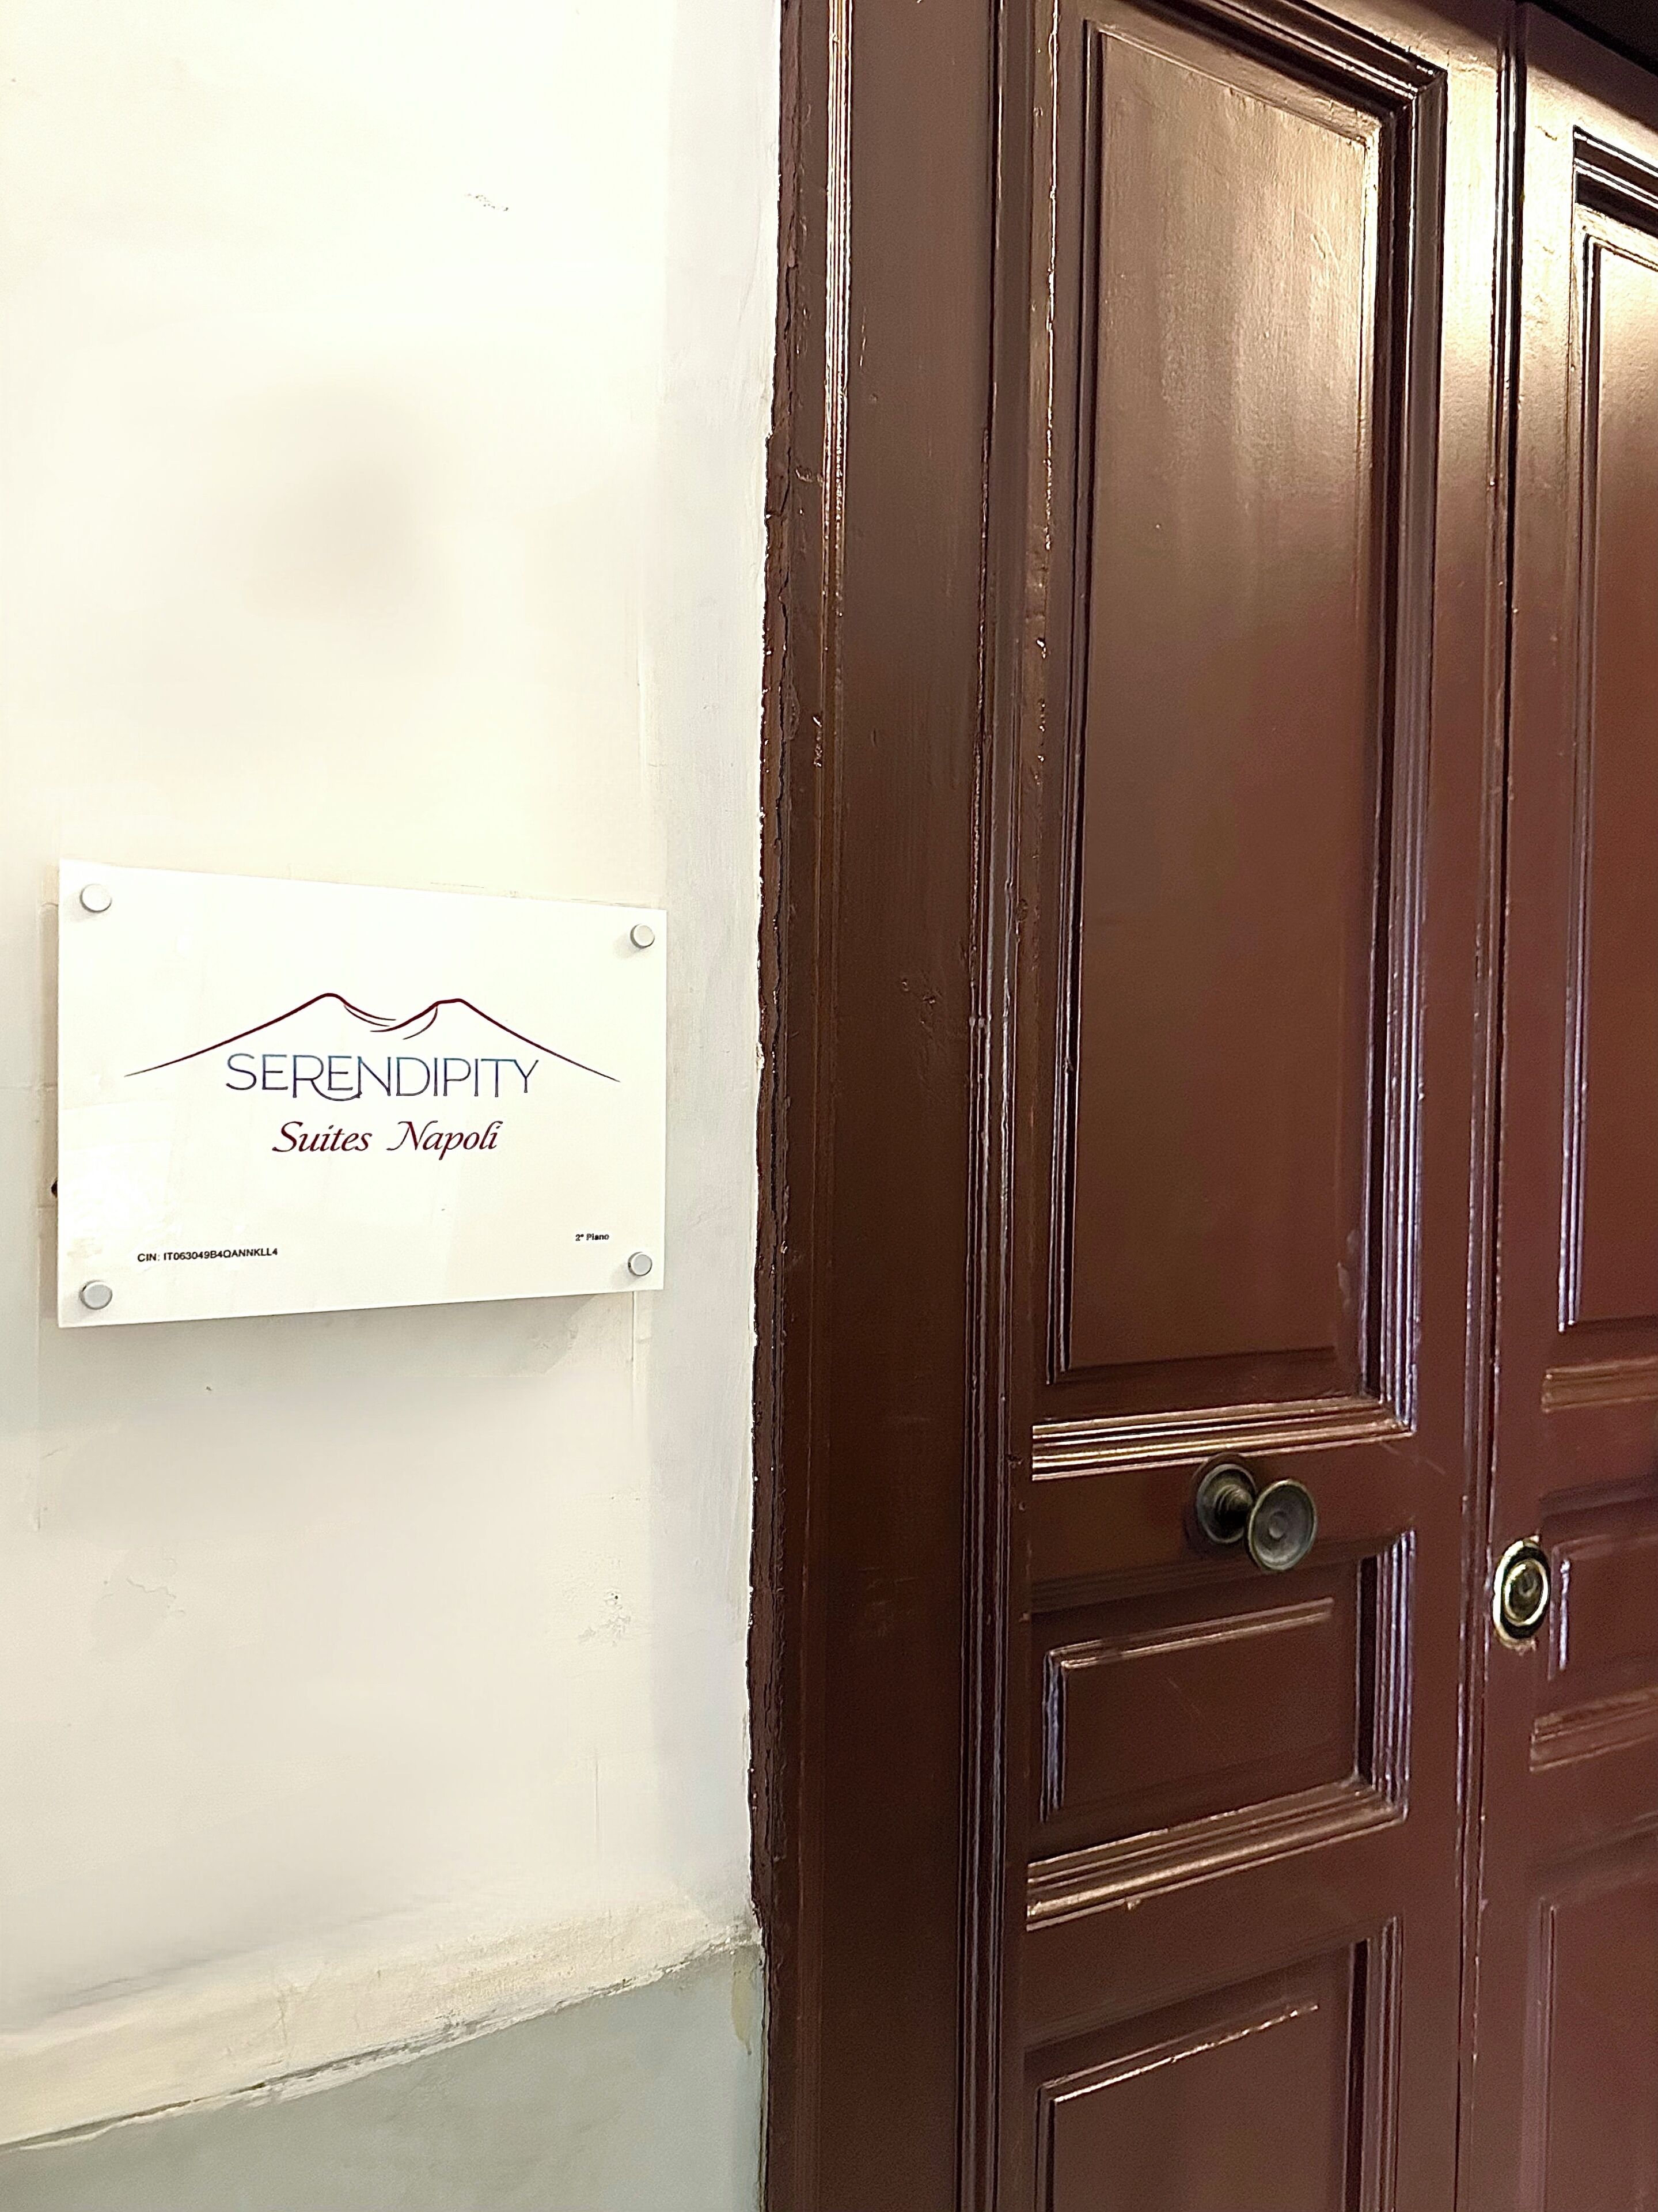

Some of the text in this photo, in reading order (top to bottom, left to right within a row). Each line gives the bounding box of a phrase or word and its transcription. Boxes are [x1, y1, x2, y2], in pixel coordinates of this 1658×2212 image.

[226, 1053, 539, 1102] SERENDIPITY
[272, 1120, 503, 1161] Suites Napoli
[586, 1233, 610, 1241] Piano
[137, 1248, 278, 1263] CIN: IT063049B4QANNKLL4
